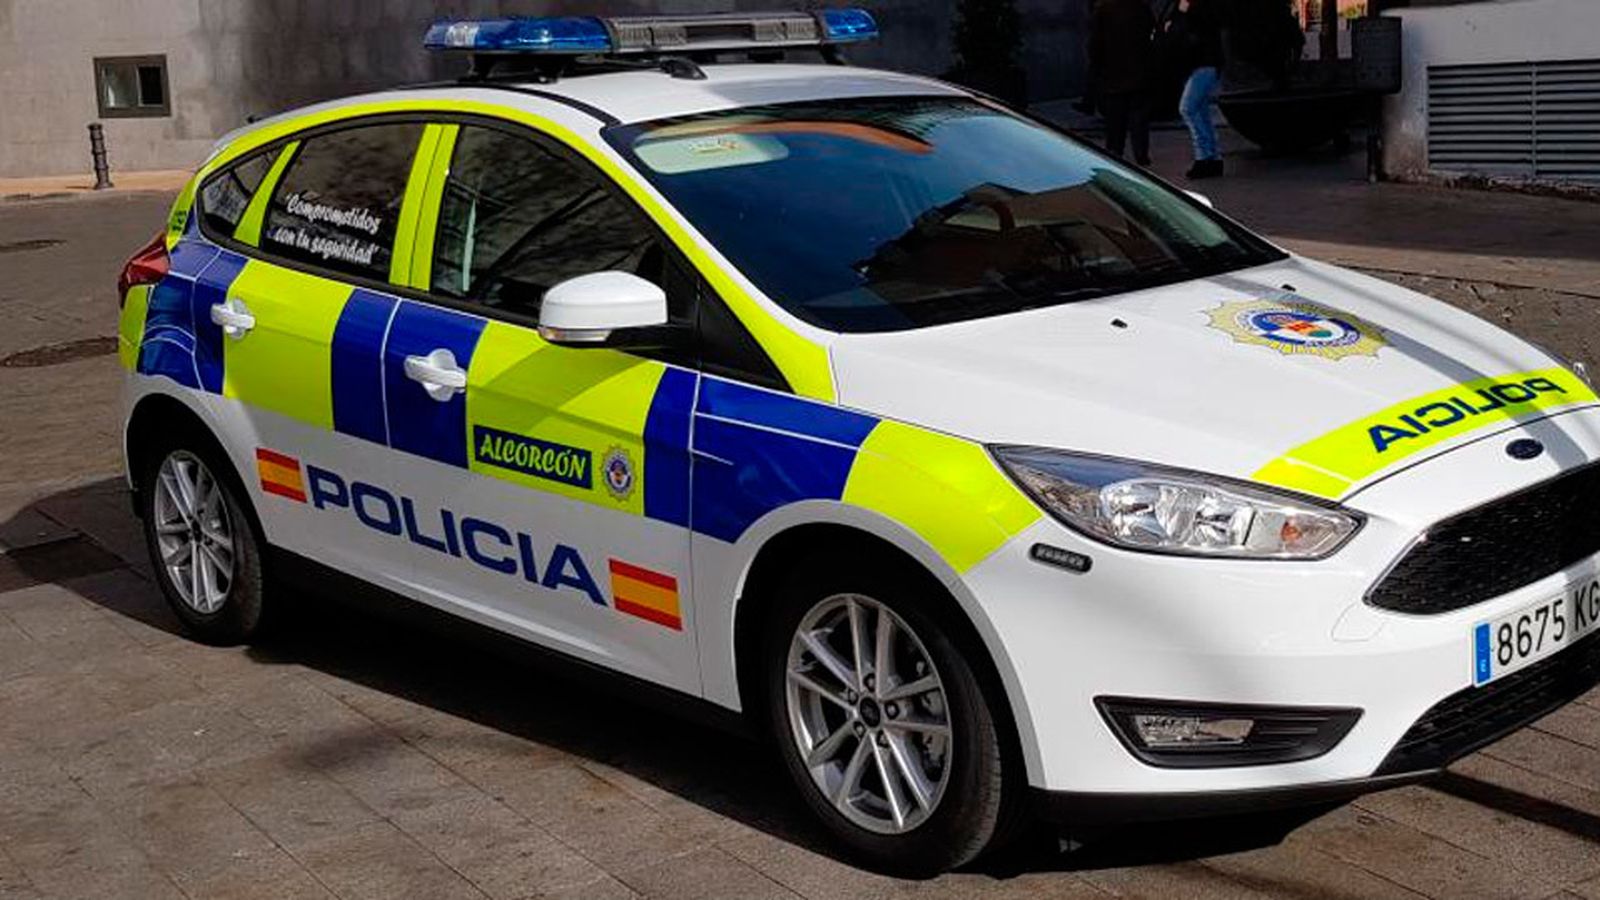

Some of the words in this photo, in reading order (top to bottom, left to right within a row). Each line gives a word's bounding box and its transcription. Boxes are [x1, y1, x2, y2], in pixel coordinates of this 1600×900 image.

[480, 433, 587, 480] ALCORCÓN
[307, 465, 608, 607] POLICIA
[1497, 598, 1566, 666] 8675
